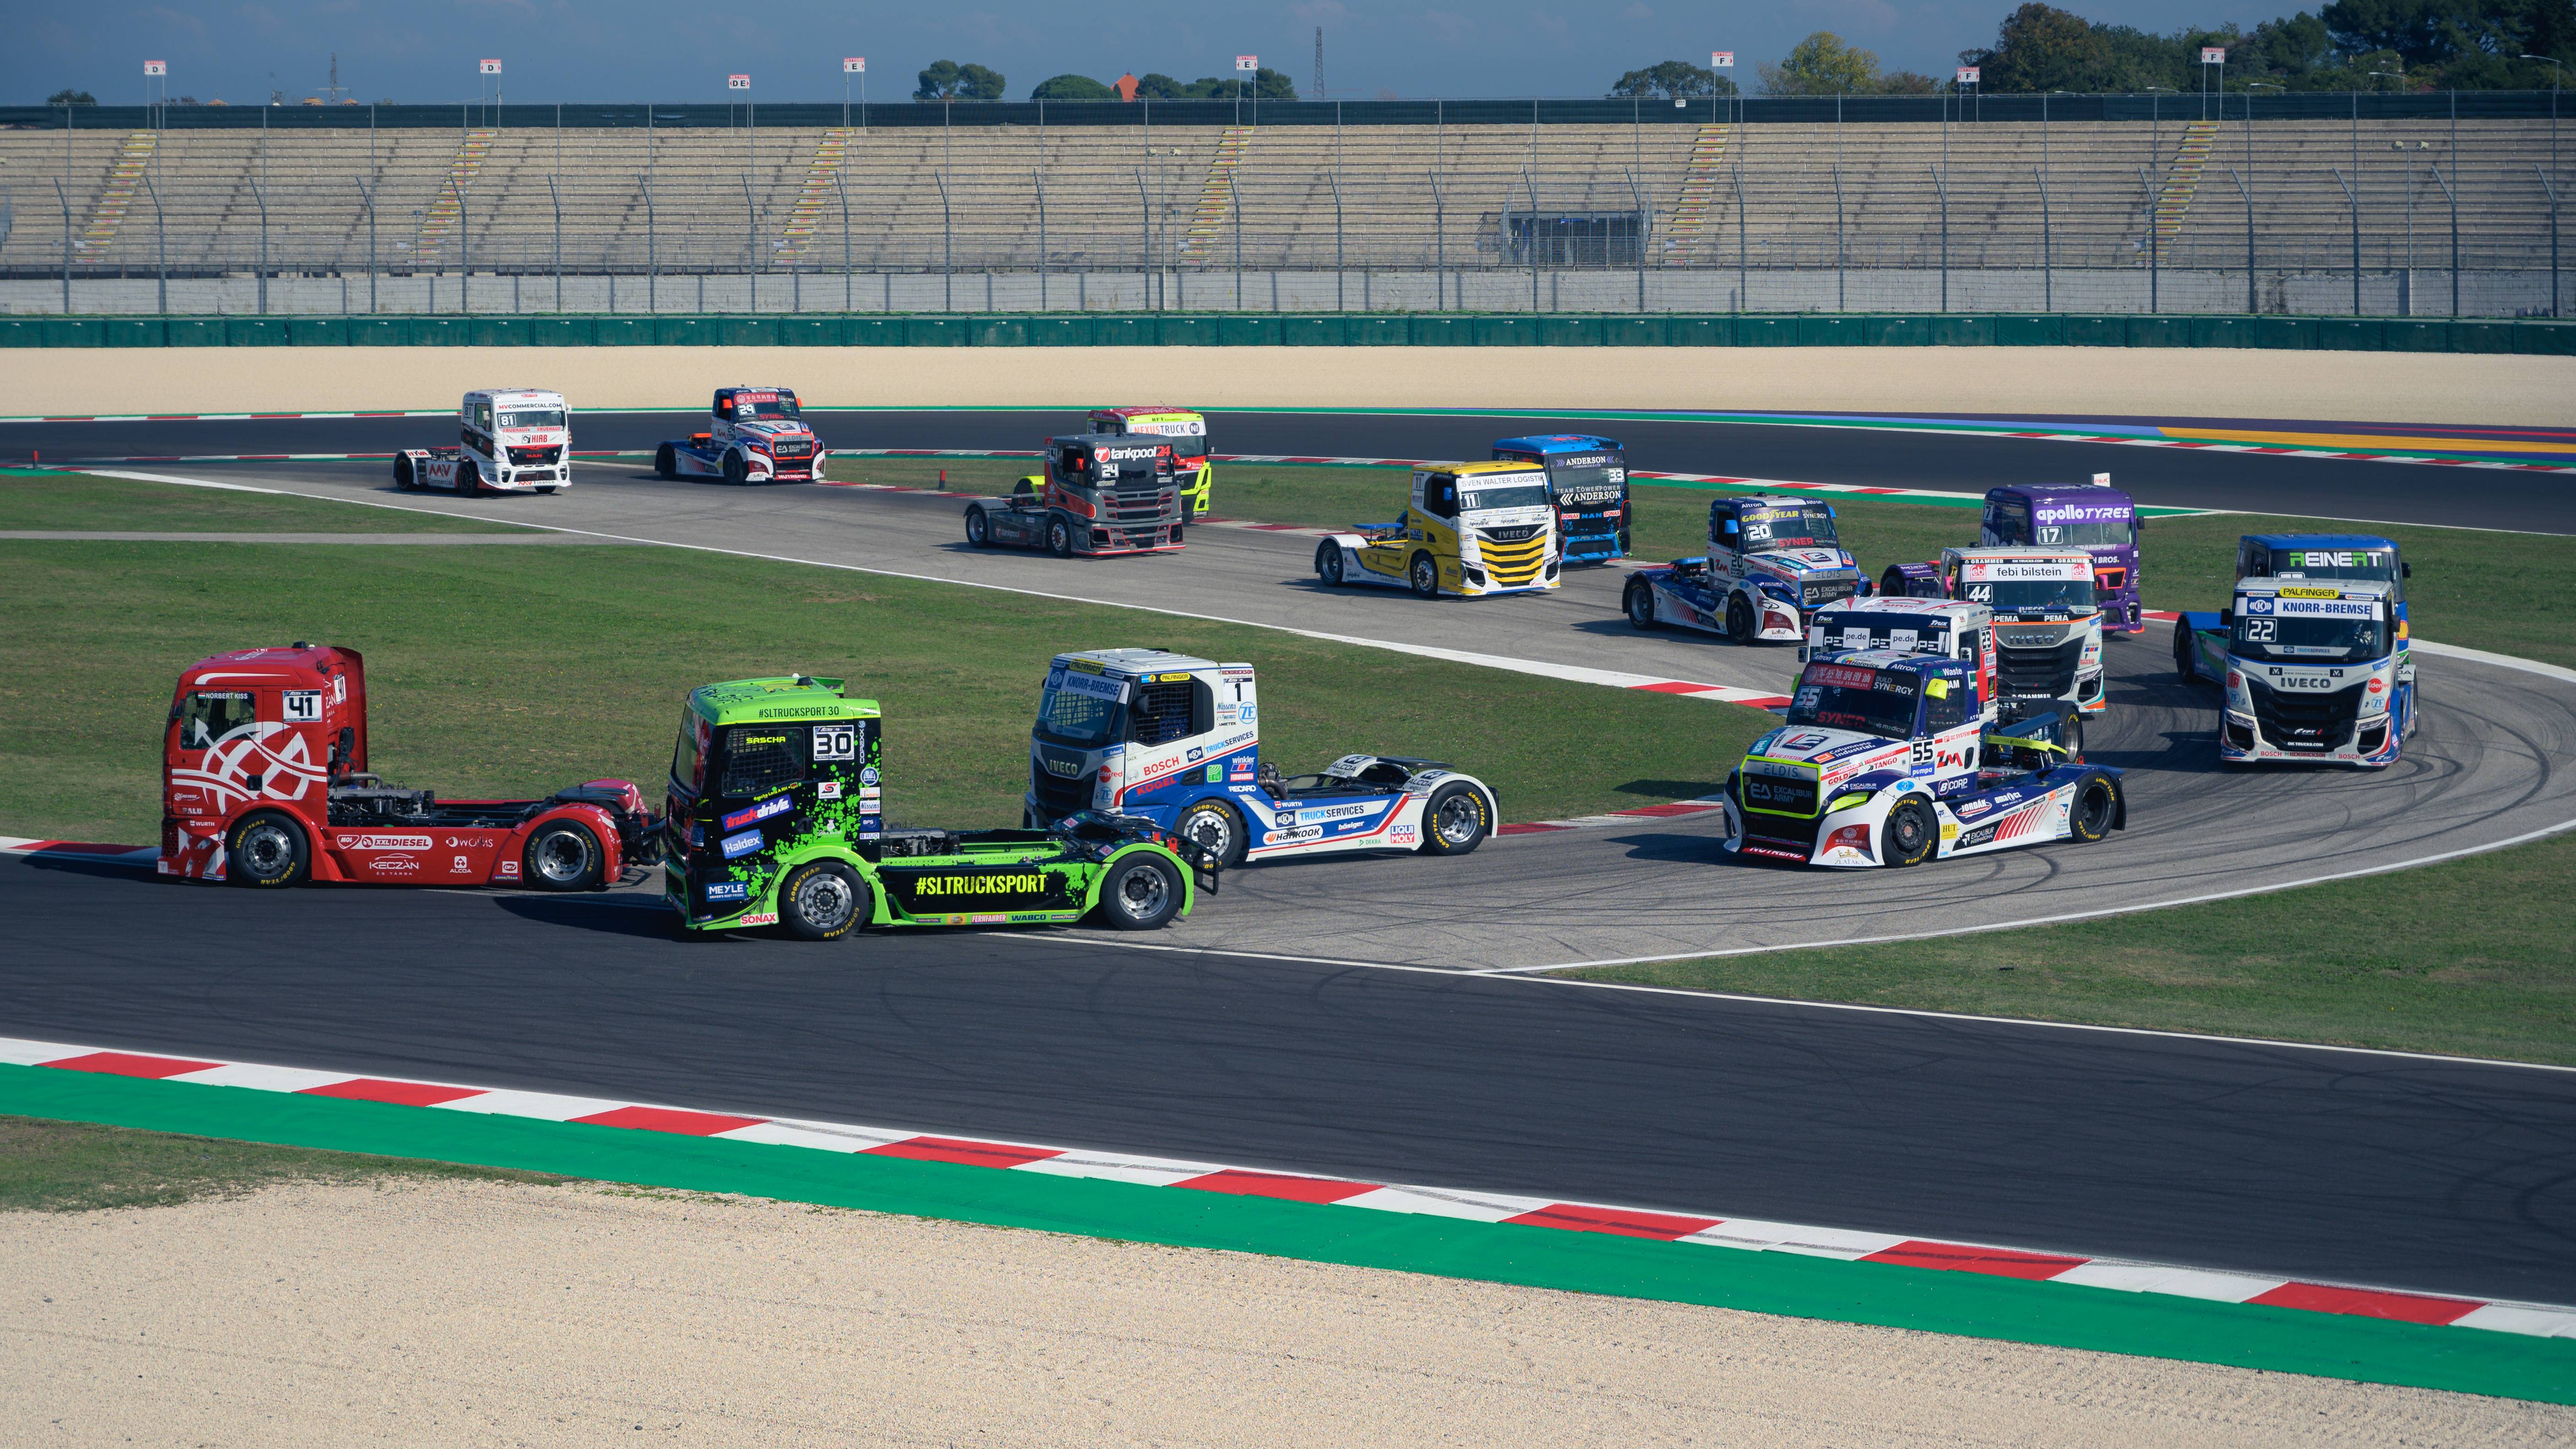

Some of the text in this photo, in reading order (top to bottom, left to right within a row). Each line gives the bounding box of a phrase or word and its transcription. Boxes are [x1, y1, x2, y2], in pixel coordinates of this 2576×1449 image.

[739, 406, 754, 414] 29
[501, 416, 514, 425] 81
[1134, 425, 1185, 434] NEXUSTRUCK
[495, 447, 505, 457] apollo
[1111, 445, 1171, 461] tankpool24
[1566, 456, 1606, 466] ANDERSON
[1102, 465, 1118, 476] 24
[1609, 469, 1623, 481] 33
[1483, 477, 1511, 485] WALTER
[1513, 475, 1543, 483] LOGISTIK
[1464, 494, 1476, 506] 11
[1574, 491, 1621, 501] ANDERSON
[1742, 510, 1799, 522] GOODYEAR
[2037, 505, 2131, 525] apollo TYRES
[1498, 530, 1529, 538] IVECO
[1748, 526, 1771, 539] 20
[2041, 528, 2060, 543] 17
[1778, 537, 1813, 548] SYNER
[1731, 554, 1743, 568] 20
[1785, 559, 1803, 569] tech
[1997, 567, 2061, 576] febi bilstein
[1969, 586, 1990, 602] 44
[2283, 588, 2335, 597] PALFINGER
[2283, 602, 2370, 615] KNORR-BREMSE
[2249, 620, 2274, 640] 22
[1846, 633, 1866, 641] pe.de
[1893, 635, 1914, 643] pe.de
[1891, 664, 1917, 672] Altron
[1933, 668, 1962, 677] BioWaste
[1067, 676, 1119, 696] KNORR-BREMSE
[1873, 682, 1913, 696] SYNERGY
[2280, 677, 2331, 689] IVECO
[1235, 683, 1241, 701] 1
[289, 697, 313, 716] 41
[759, 706, 839, 718] #SLTRUCKSPORT 30
[817, 734, 851, 755] 30
[1205, 731, 1254, 754] TRUCKSERVICES
[1913, 741, 1933, 762] 55
[1049, 759, 1078, 775] IVECO
[1144, 756, 1179, 776] BOSCH
[1330, 763, 1357, 771] ALCOA
[1875, 757, 1897, 769] TANGO
[1764, 764, 1798, 778] ELDIS
[1913, 767, 1932, 776] pumpa
[1407, 779, 1433, 787] ALCOA
[1828, 772, 1849, 785] GOLD
[861, 801, 880, 810] Nissens
[1962, 799, 1986, 813] JORDÁK
[726, 799, 789, 829] truckdrive
[1300, 806, 1364, 821] TRUCKSERVICES
[1391, 826, 1414, 835] LIQUI
[1391, 834, 1414, 843] MOLY
[725, 836, 760, 854] Haldex
[369, 859, 419, 869] KECZÁN
[709, 884, 744, 895] MEYLE
[917, 874, 1047, 895] #SLTRUCKSPORT
[741, 914, 777, 925] SONAX
